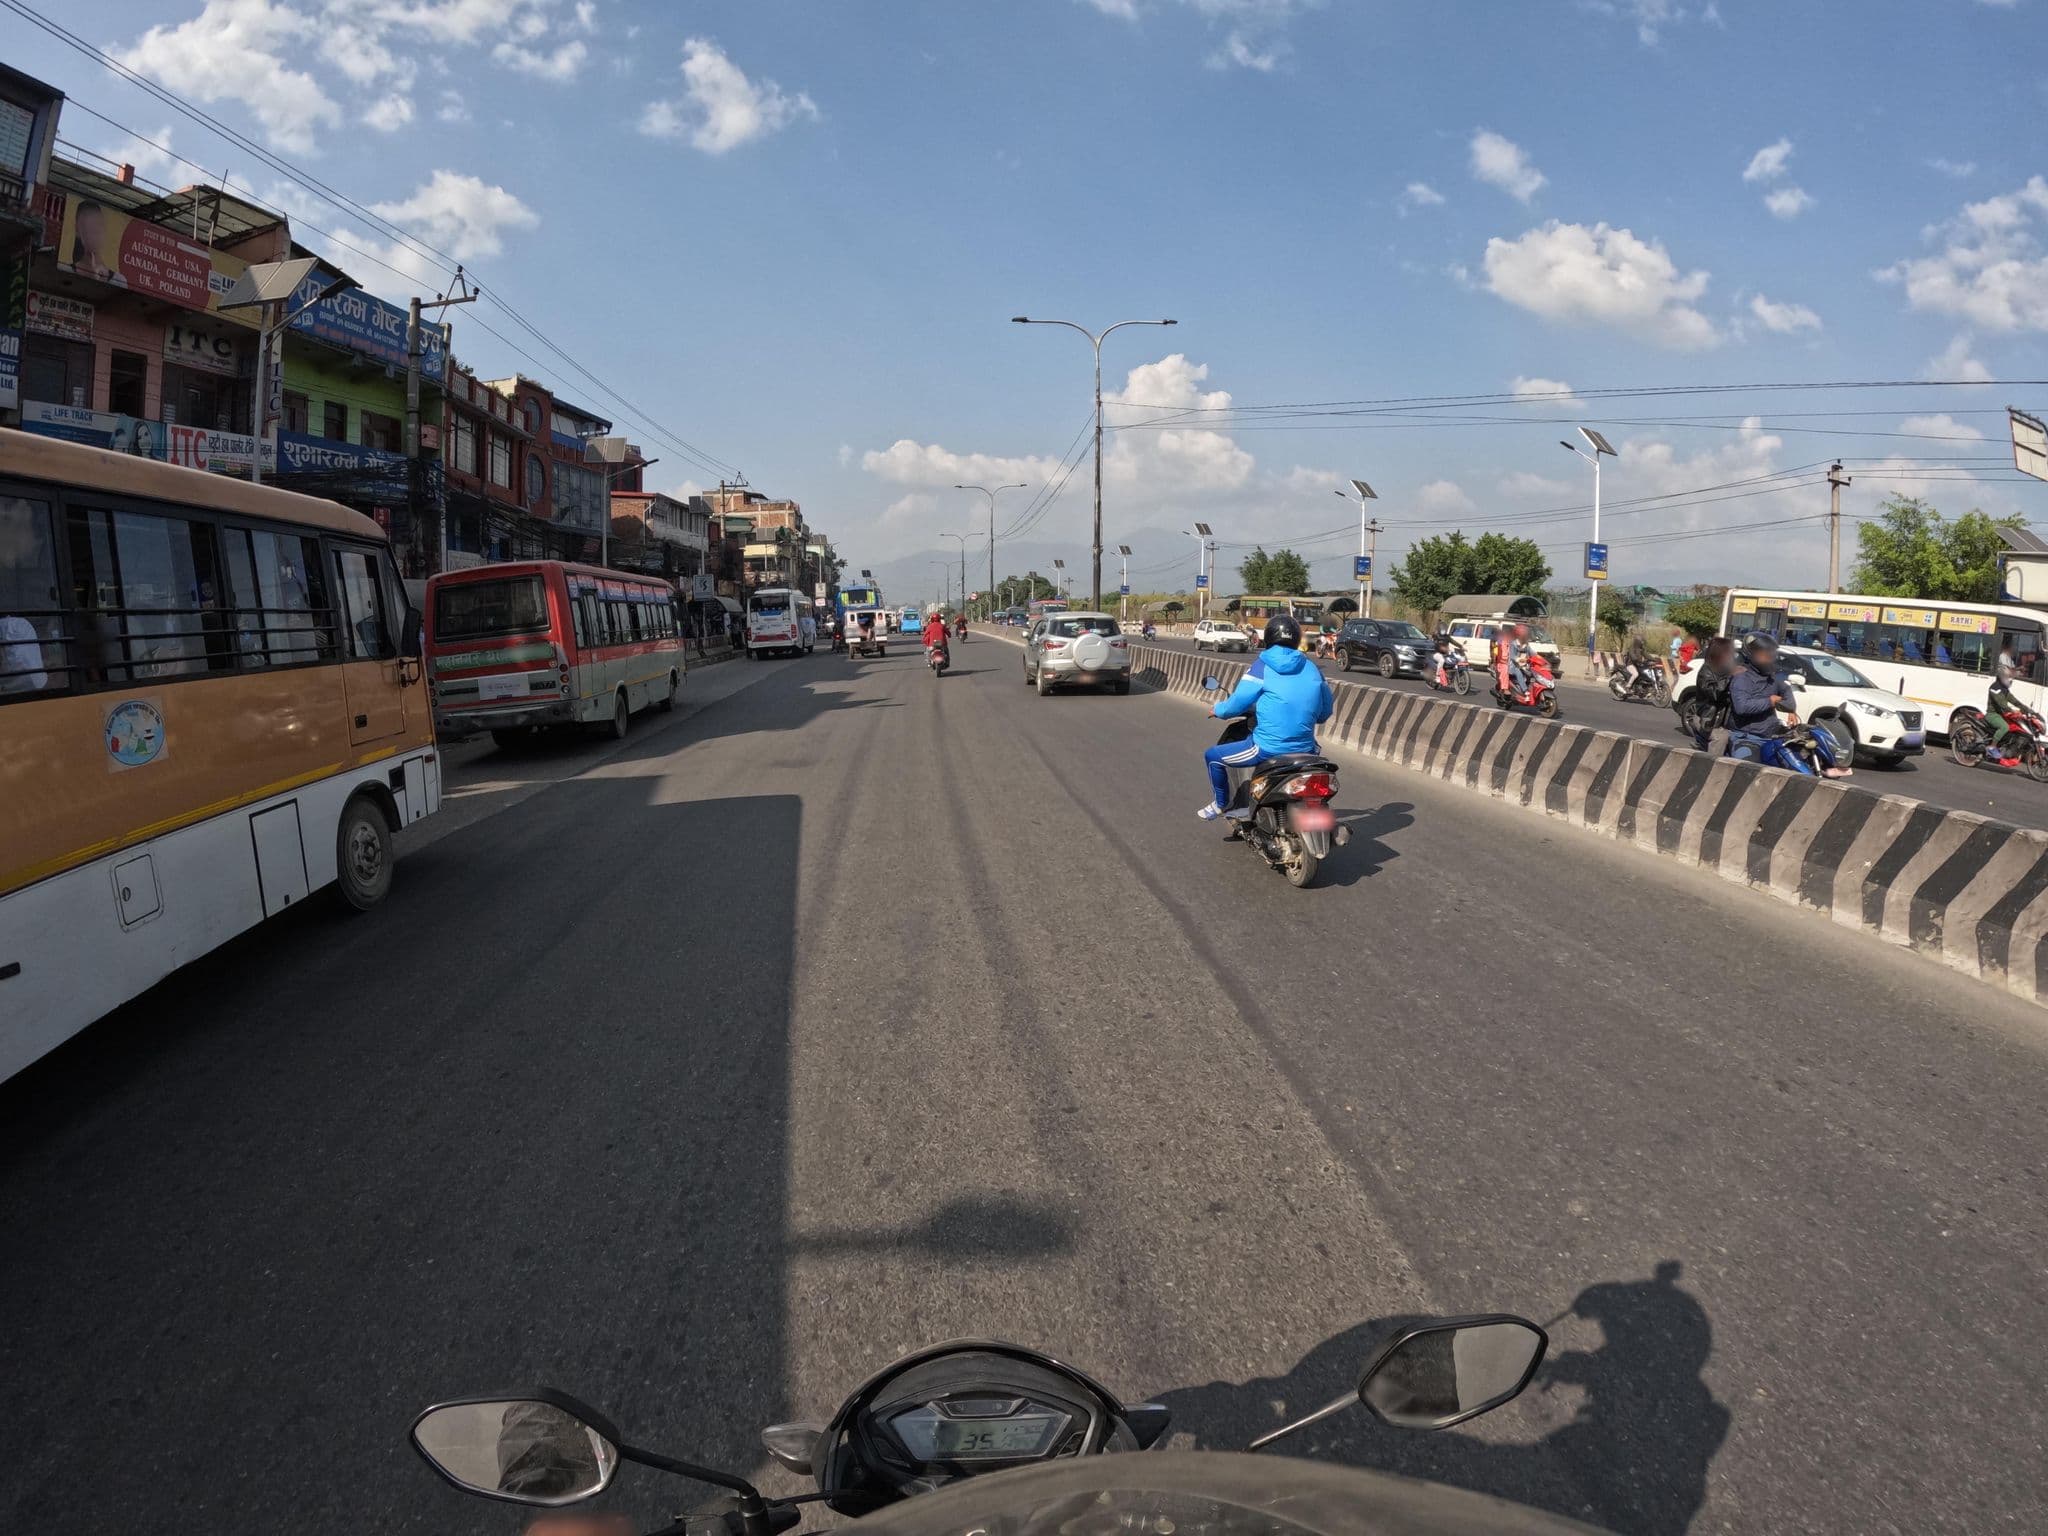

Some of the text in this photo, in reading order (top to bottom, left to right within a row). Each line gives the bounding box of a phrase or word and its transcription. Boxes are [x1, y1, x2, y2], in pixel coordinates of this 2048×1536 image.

[132, 241, 202, 274] AUSTRALIA, USA,
[123, 253, 207, 291] CANADA, GERMANY,
[222, 277, 236, 290] LIF
[159, 281, 191, 300] POLAND
[0, 335, 20, 357] an
[170, 325, 233, 358] ITC
[54, 407, 69, 419] LIFE
[71, 409, 93, 422] TRACK
[171, 426, 208, 469] ITC
